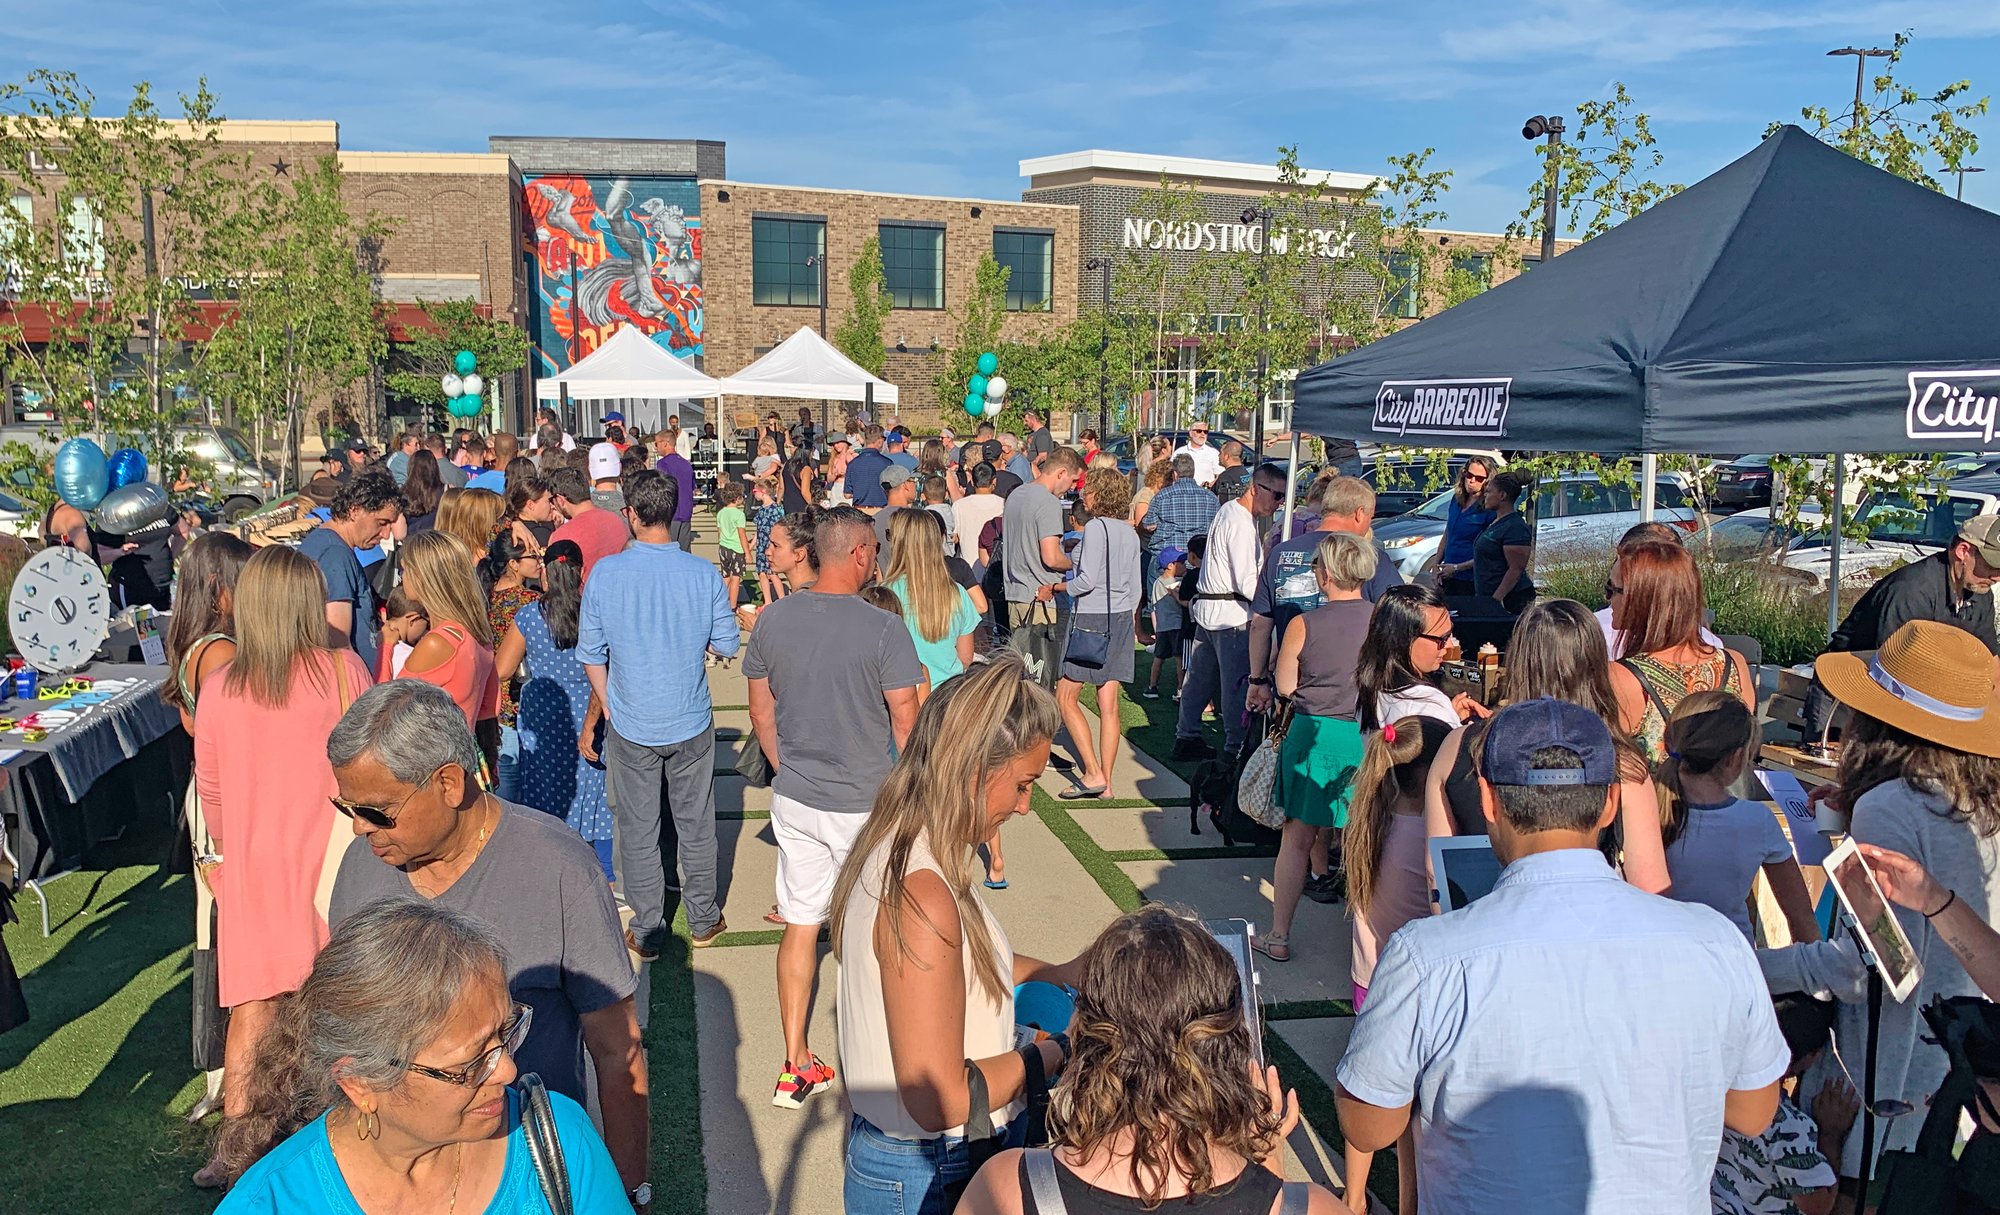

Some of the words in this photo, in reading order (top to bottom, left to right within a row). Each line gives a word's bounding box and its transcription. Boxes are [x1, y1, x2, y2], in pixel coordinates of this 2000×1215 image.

[1124, 217, 1288, 255] NORDSTROM
[1378, 388, 1413, 438] City
[1409, 387, 1504, 426] BARBEQUE
[1917, 381, 1999, 444] City
